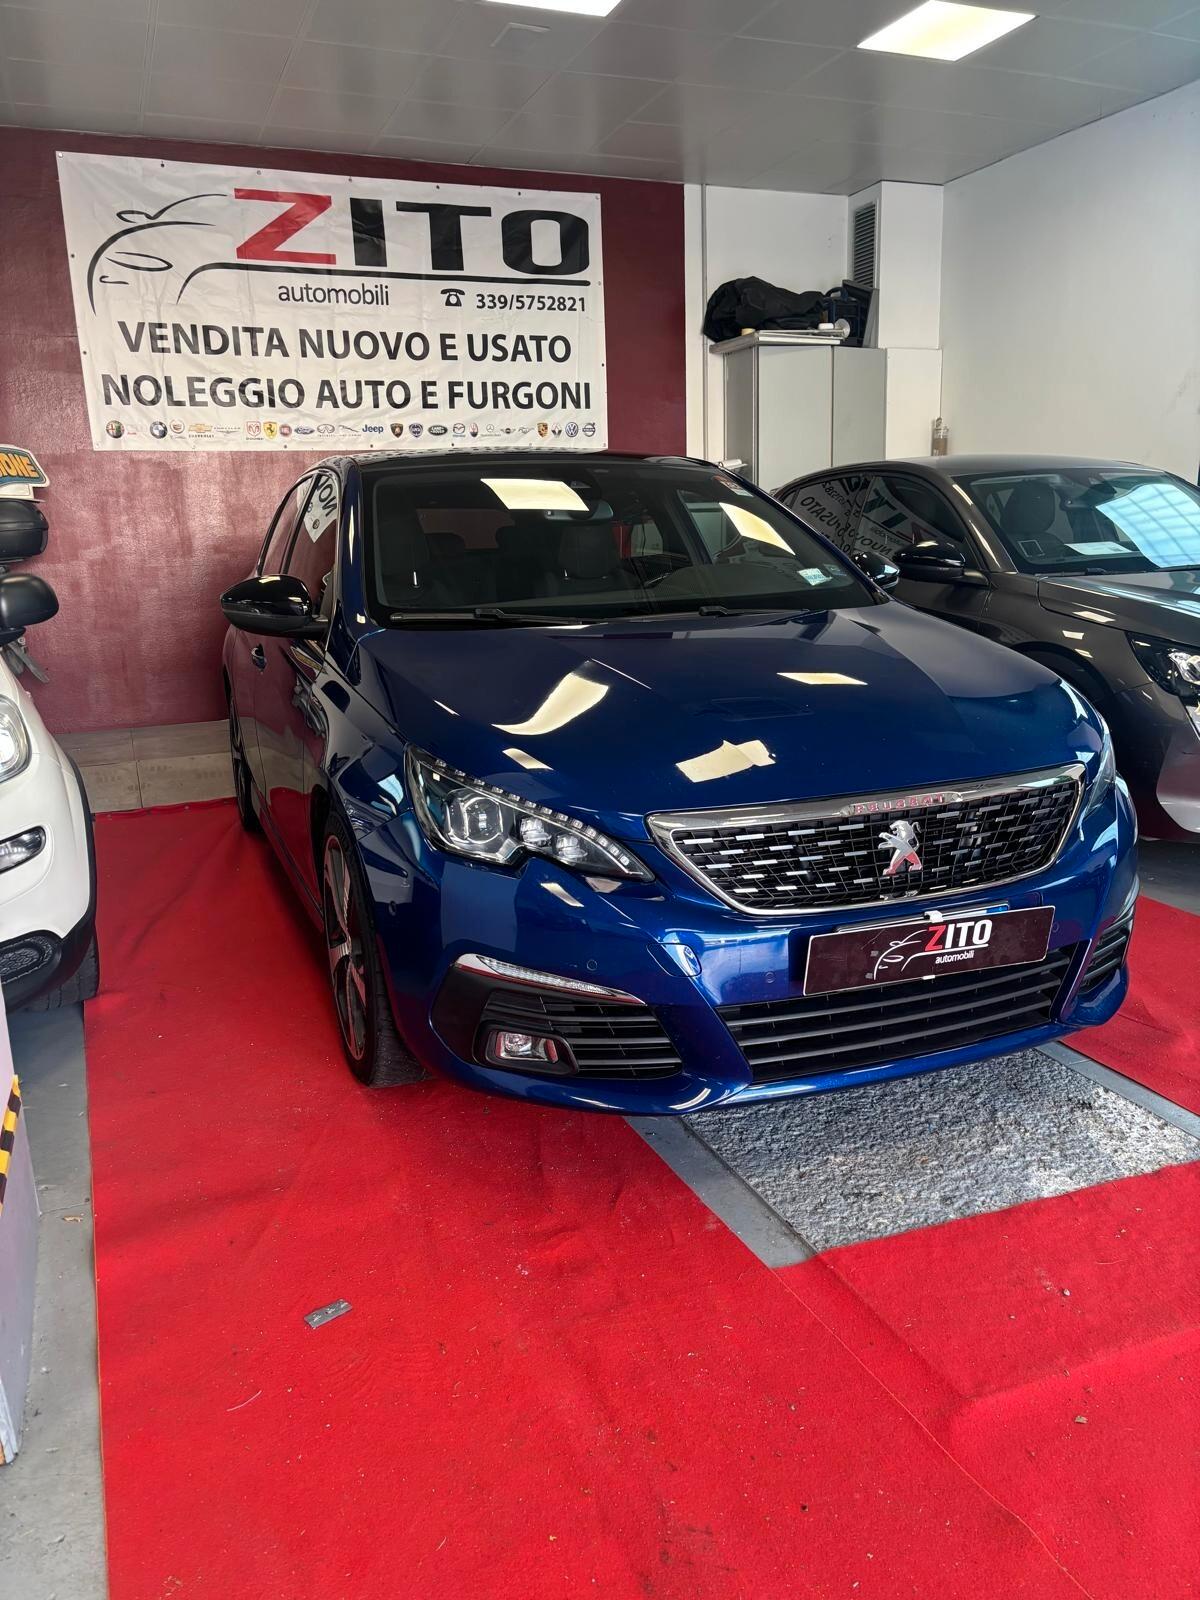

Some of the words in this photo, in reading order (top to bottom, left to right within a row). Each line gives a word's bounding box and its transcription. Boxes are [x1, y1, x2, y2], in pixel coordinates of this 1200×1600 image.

[234, 188, 590, 276] ZITO
[278, 283, 389, 306] automobili
[476, 293, 586, 312] 339/5752821
[117, 321, 290, 358] VENDITA
[299, 328, 430, 362] NUOVO
[439, 333, 459, 361] E
[466, 333, 572, 363] USATO
[101, 373, 305, 409] NOLEGGIO
[315, 379, 412, 410] AUTO
[421, 380, 439, 410] E
[447, 381, 591, 410] FURGONI
[362, 424, 384, 434] Jeep
[925, 919, 993, 952] ZITO
[935, 950, 975, 964] automobili
